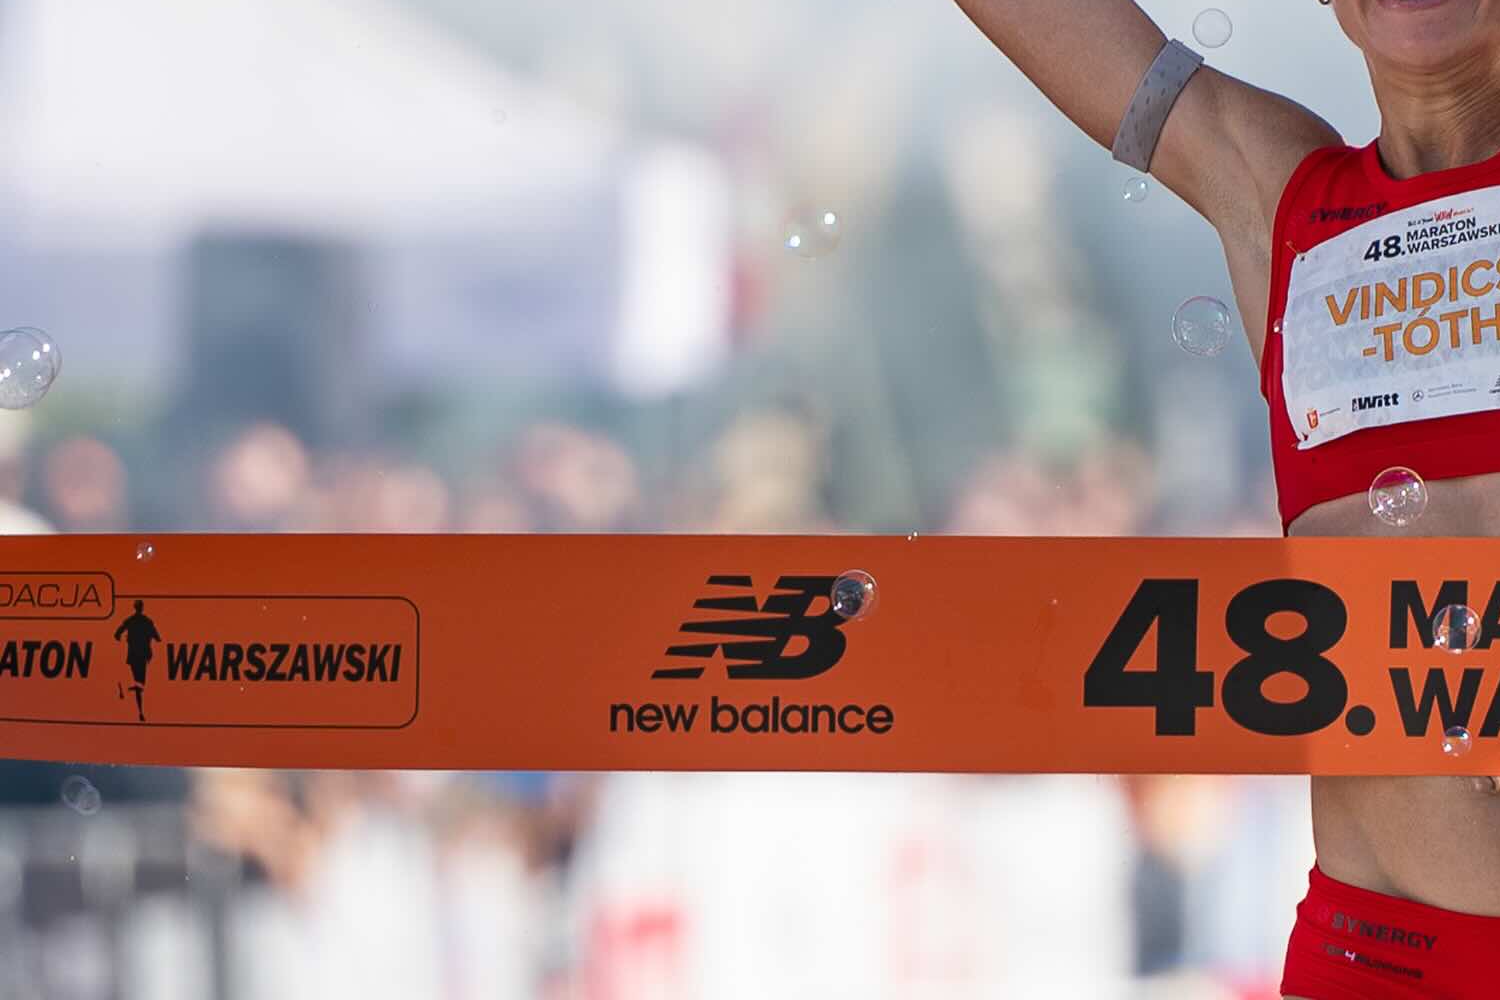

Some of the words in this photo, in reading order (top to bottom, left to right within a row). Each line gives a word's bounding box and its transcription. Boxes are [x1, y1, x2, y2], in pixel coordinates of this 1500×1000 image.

[1363, 234, 1406, 262] 48.
[1406, 216, 1476, 243] MARATON
[166, 643, 402, 682] WARSZAWSKI
[1083, 578, 1376, 737] 48.
[610, 703, 699, 733] new
[710, 695, 894, 734] balance
[1332, 911, 1438, 951] SYNERGY
